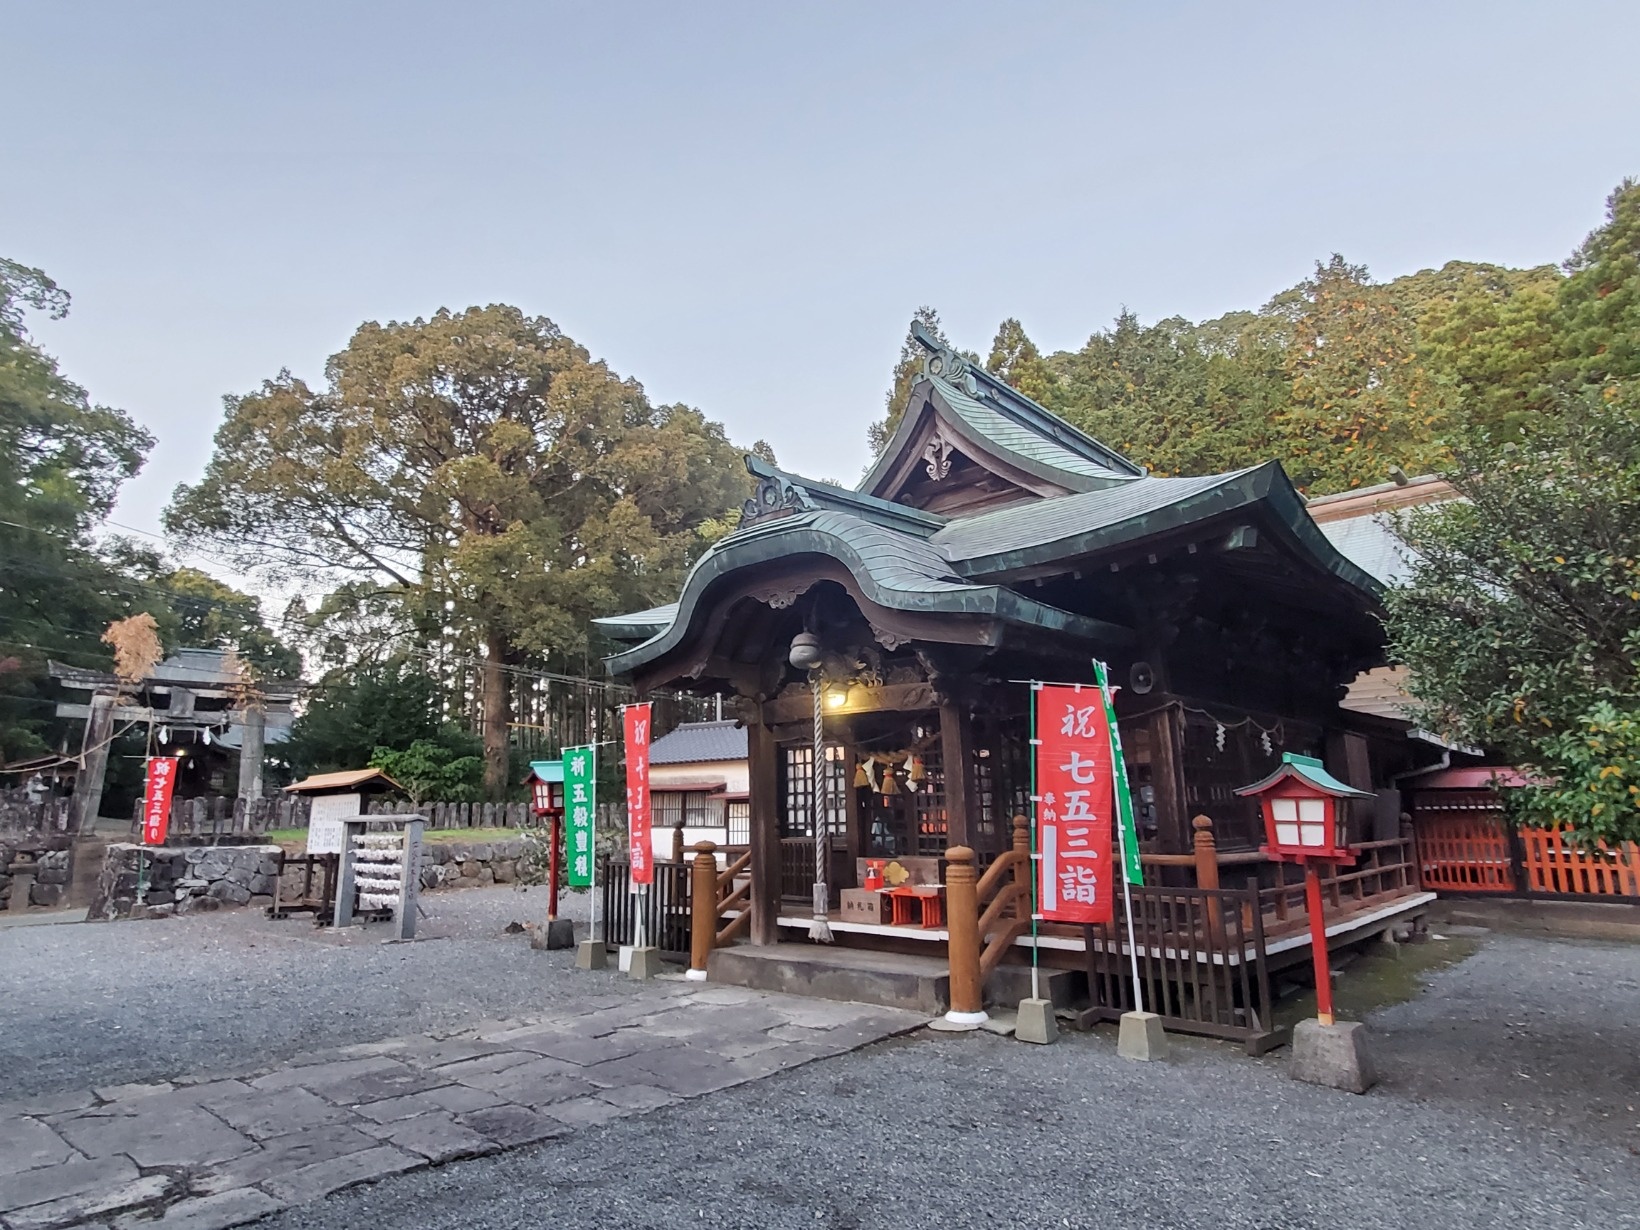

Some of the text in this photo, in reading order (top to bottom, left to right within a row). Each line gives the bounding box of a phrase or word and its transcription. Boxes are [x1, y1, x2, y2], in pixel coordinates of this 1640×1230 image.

[1042, 791, 1057, 822] 奉納
[1058, 704, 1098, 905] 祝七五三詣
